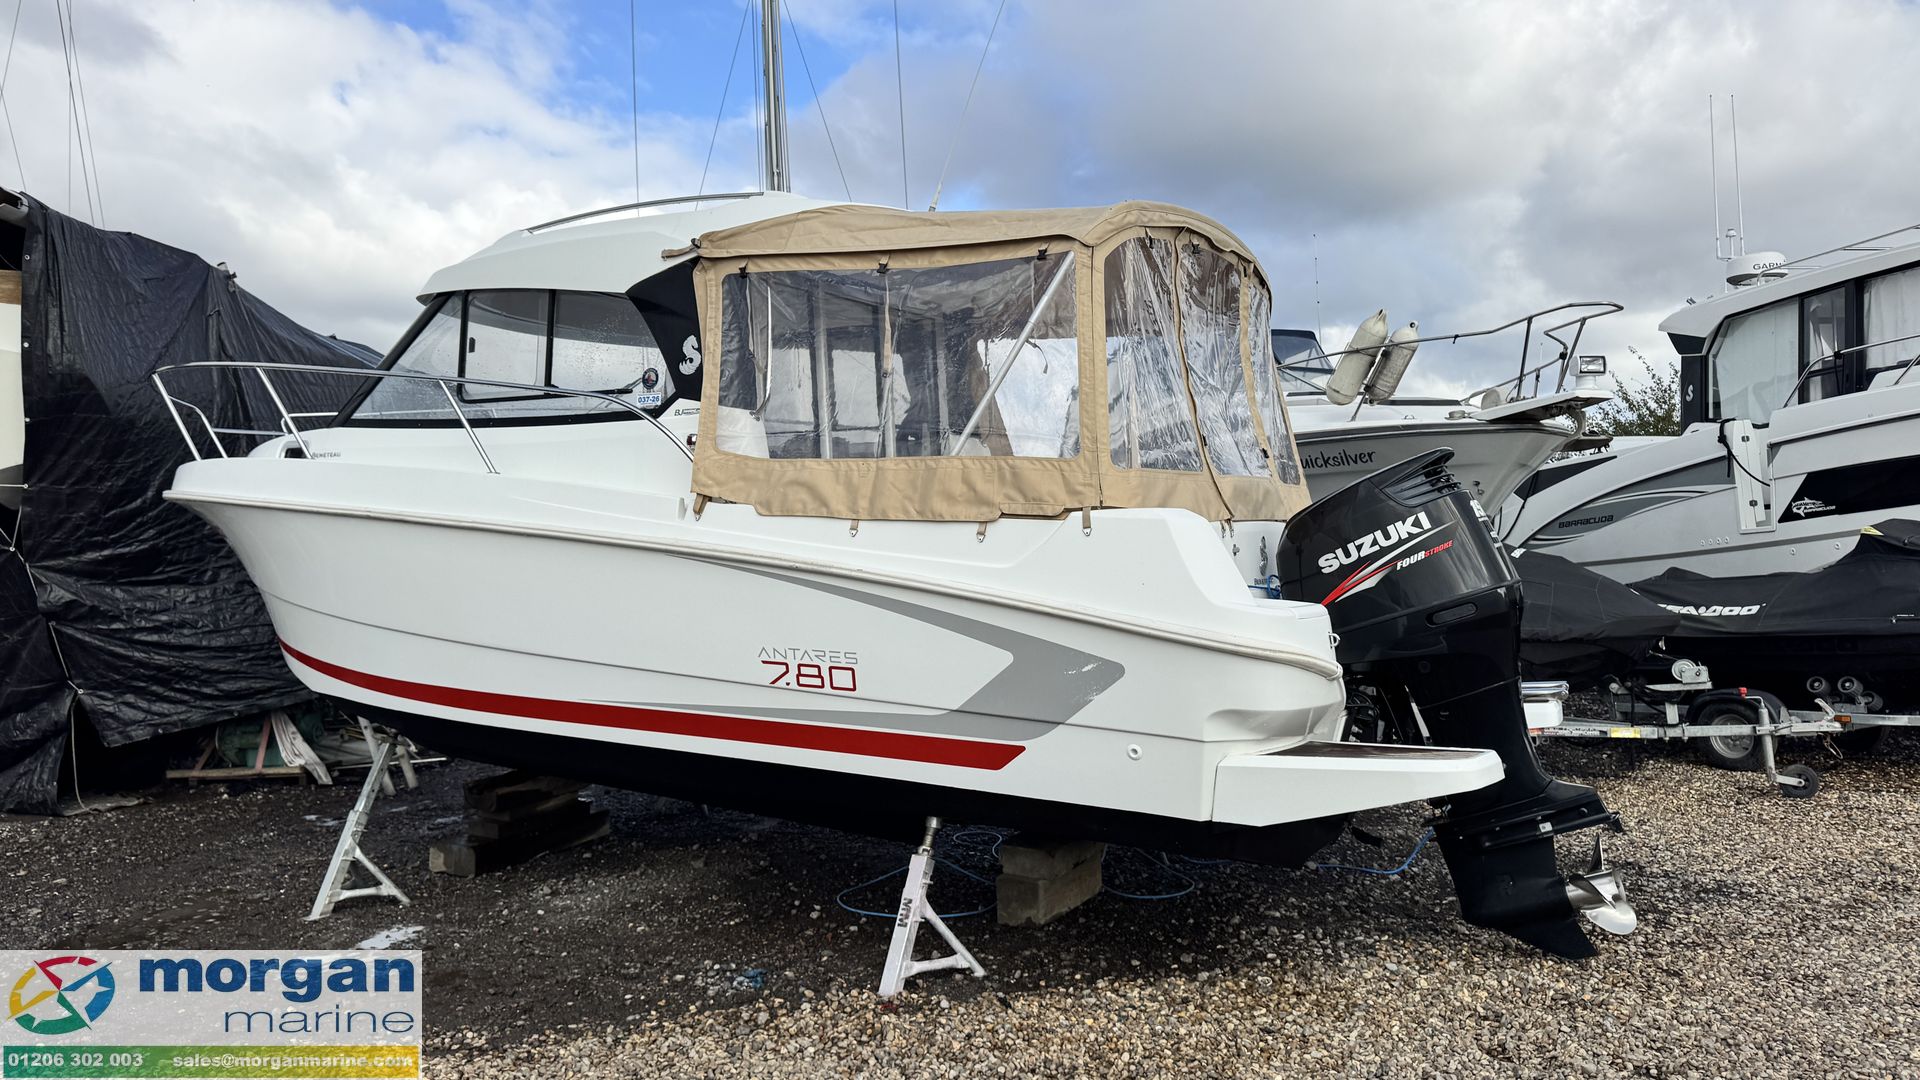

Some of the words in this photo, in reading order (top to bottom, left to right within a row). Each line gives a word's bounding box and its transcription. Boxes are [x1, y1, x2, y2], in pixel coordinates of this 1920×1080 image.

[1300, 449, 1376, 469] uicksilver
[1318, 511, 1432, 574] SUZUKI
[758, 646, 858, 664] ANTARES
[761, 660, 857, 692] 7.80
